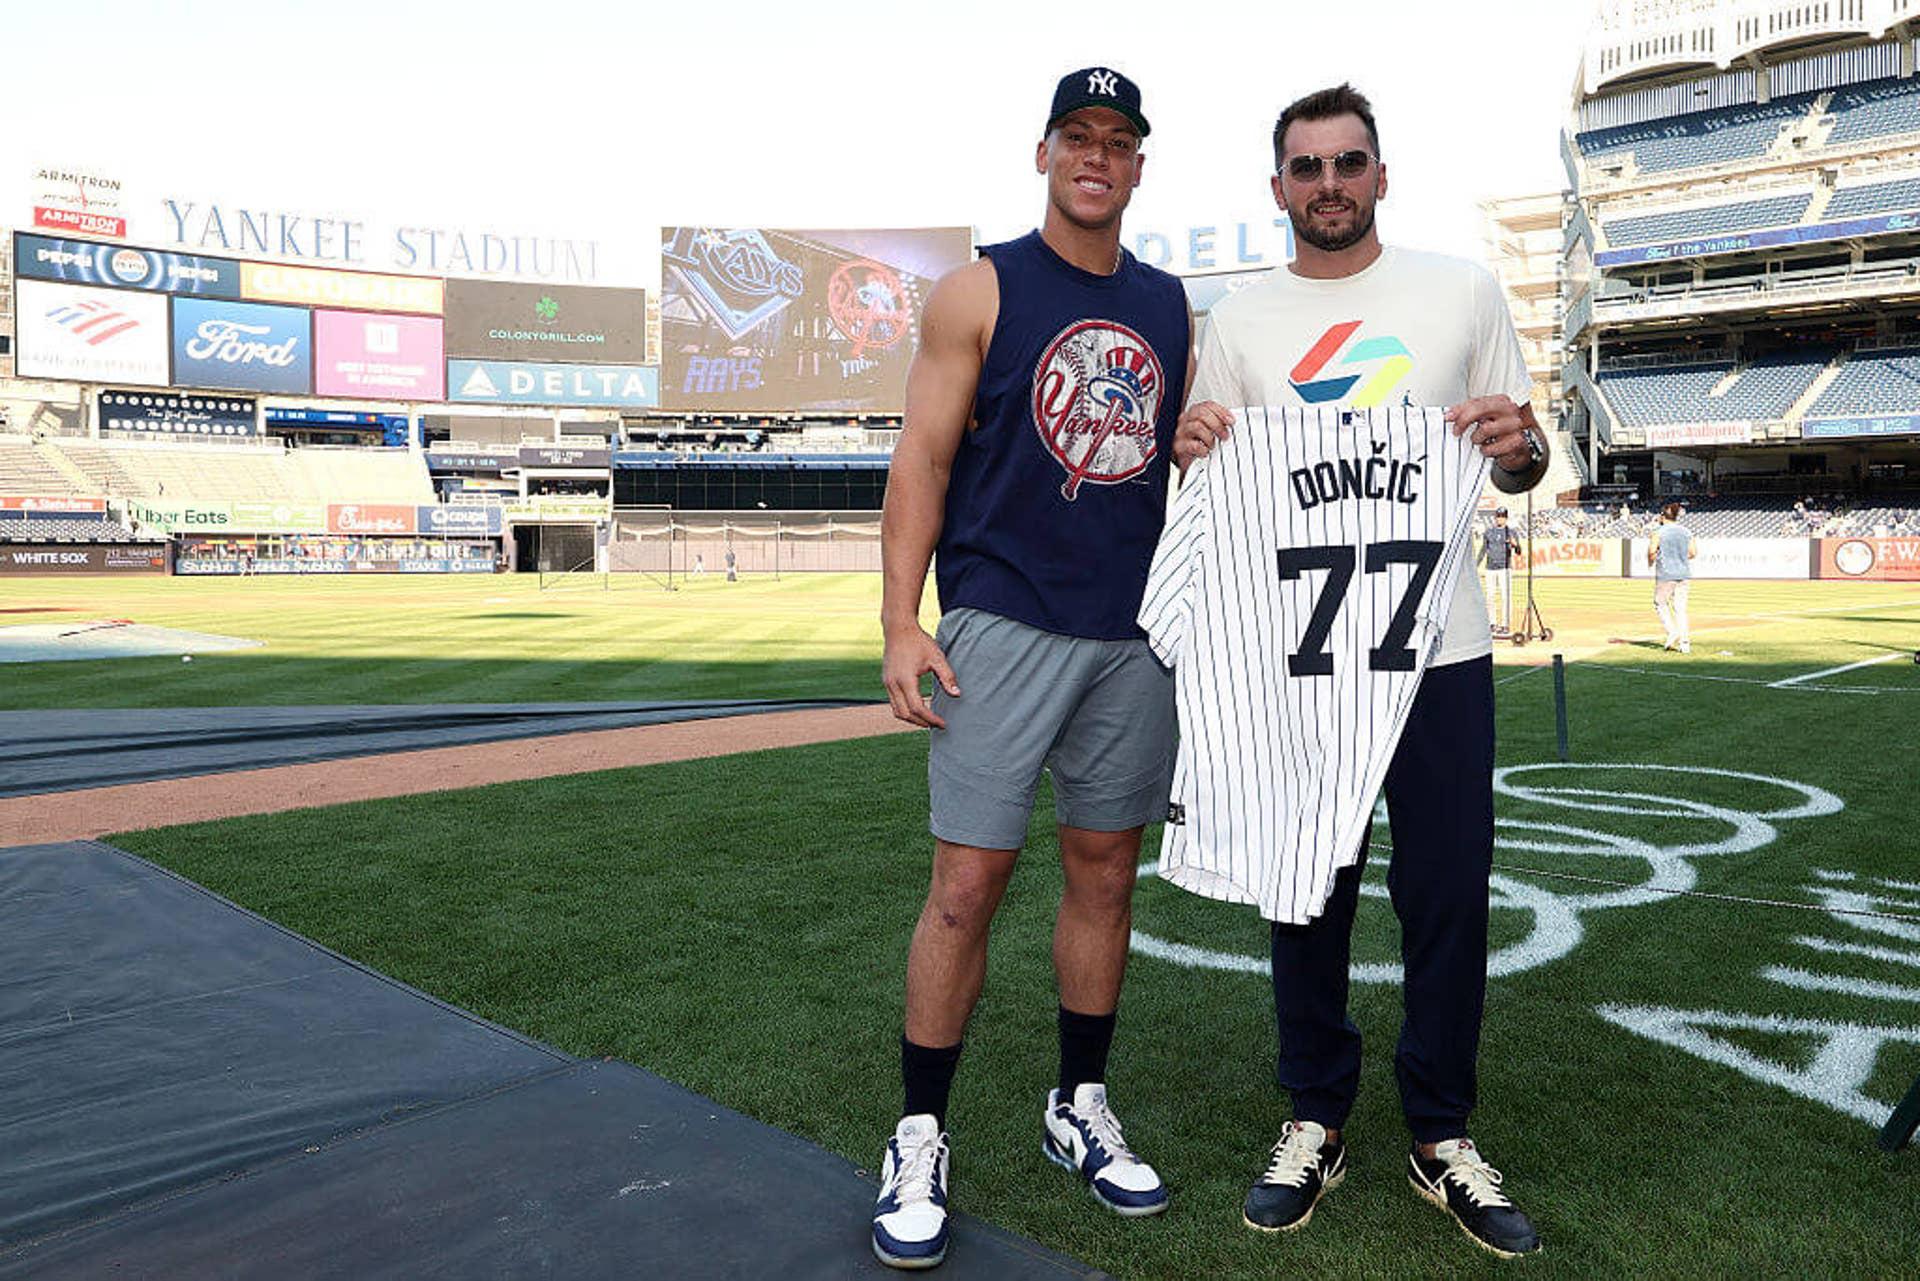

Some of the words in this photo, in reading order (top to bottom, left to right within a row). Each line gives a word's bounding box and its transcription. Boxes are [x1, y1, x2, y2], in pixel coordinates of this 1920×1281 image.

[1087, 69, 1118, 97] NY
[38, 169, 121, 191] ARMITRON
[162, 198, 365, 263] YANKEE
[394, 224, 600, 283] STADIUM
[1136, 217, 1295, 270] DELT
[186, 319, 298, 367] Ford
[488, 329, 605, 343] COLONYGRILL.COM
[510, 370, 647, 397] DELTA
[683, 356, 763, 394] RAYS
[1291, 439, 1429, 511] DONČIĆ
[136, 508, 179, 524] Uber
[184, 509, 229, 525] Eats
[12, 553, 59, 564] WHITE
[60, 552, 89, 564] SOX
[182, 560, 235, 573] StubHub
[1531, 542, 1604, 568] MASON
[1276, 539, 1447, 678] 77
